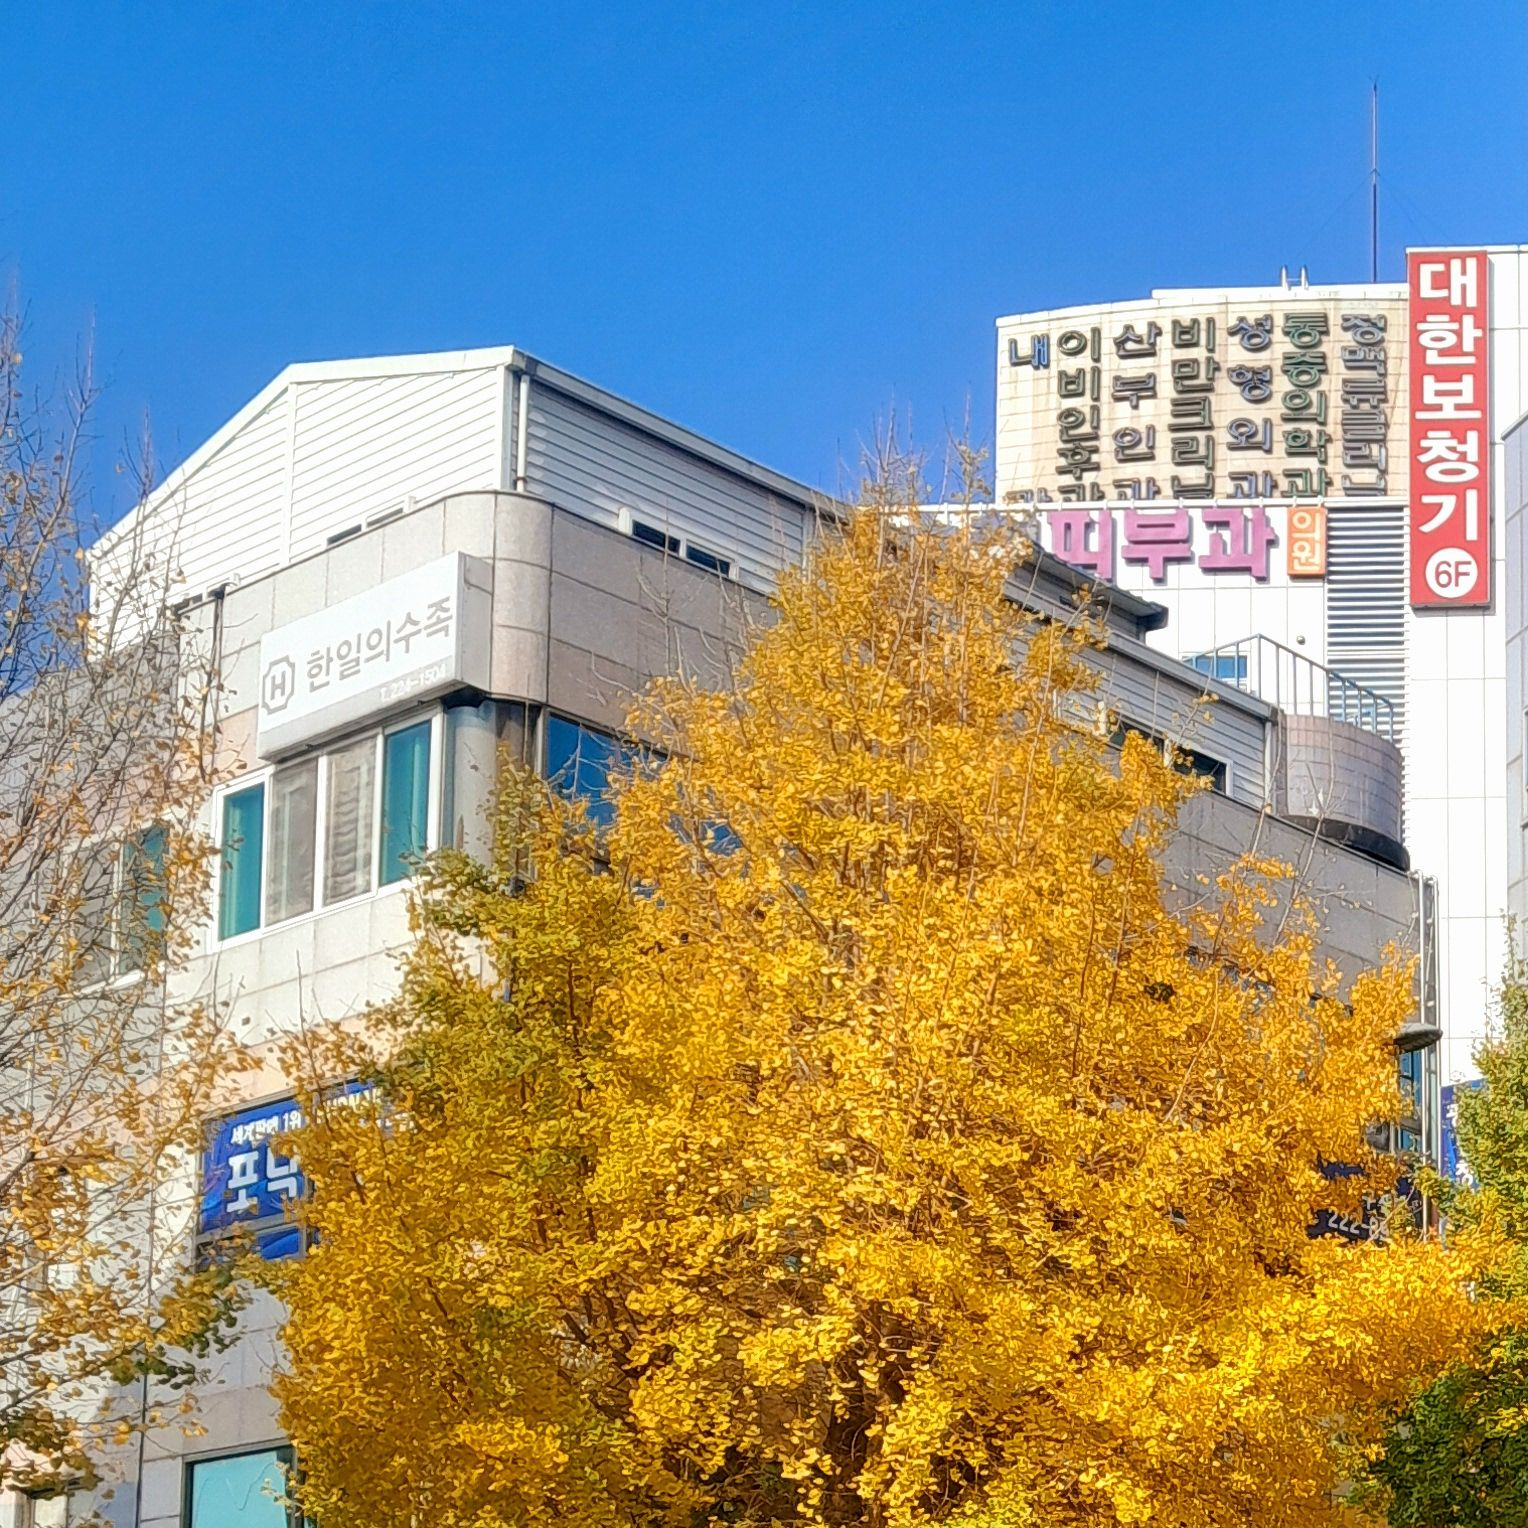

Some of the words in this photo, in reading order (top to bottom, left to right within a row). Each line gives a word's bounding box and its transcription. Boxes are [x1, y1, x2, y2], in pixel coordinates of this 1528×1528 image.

[1227, 314, 1277, 499] 성형외과
[1281, 312, 1333, 498] 통증의학과
[1415, 257, 1483, 541] 대한보청기
[1047, 507, 1277, 582] 피부과
[1292, 512, 1323, 572] 의원
[1433, 560, 1473, 589] 6F
[307, 596, 453, 693] 한일의수족
